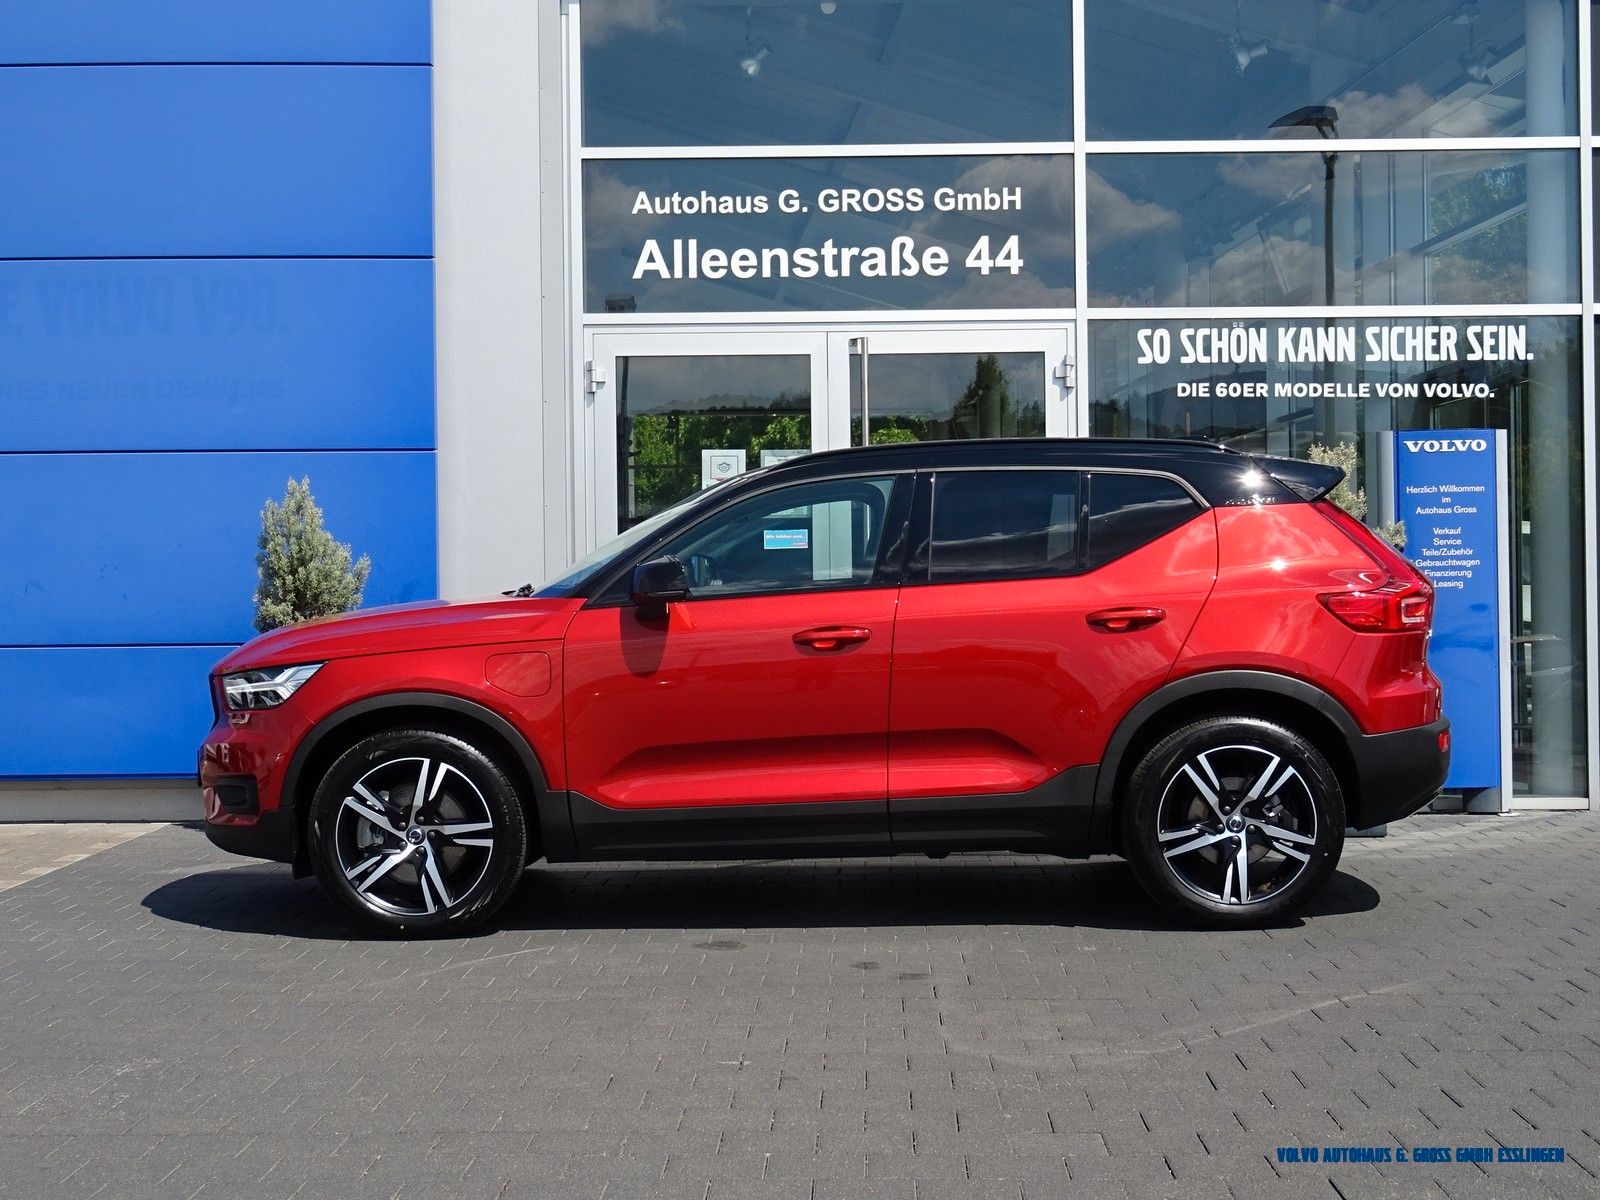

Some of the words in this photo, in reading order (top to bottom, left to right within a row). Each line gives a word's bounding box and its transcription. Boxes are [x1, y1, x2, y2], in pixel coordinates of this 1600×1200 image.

[631, 189, 768, 215] Autohaus
[778, 189, 808, 214] G.
[818, 188, 924, 213] GROSS
[933, 187, 1022, 212] GmbH
[632, 235, 949, 279] Alleenstraße
[965, 235, 1024, 275] 44
[1137, 328, 1170, 364] SO
[1180, 322, 1267, 363] SCHÖN
[1278, 327, 1356, 363] KANN
[1366, 326, 1457, 362] SICHER
[1466, 325, 1534, 361] SEIN.
[1177, 383, 1210, 398] DIE
[1215, 382, 1269, 398] 60ER
[1274, 382, 1370, 398] MODELLE
[1375, 382, 1418, 398] VON
[1423, 382, 1495, 398] VOLVO.
[1403, 439, 1487, 453] VOLVO
[1406, 486, 1437, 494] Herzlich
[1439, 485, 1485, 493] Willkommen
[1415, 506, 1452, 514] Autohaus
[1433, 527, 1462, 535] Verkauf
[1422, 548, 1473, 556] Teile/Zubehör
[1415, 559, 1480, 568] Gebrauchtwagen
[1424, 570, 1472, 579] Finanzierung
[1434, 580, 1463, 589] Leasing
